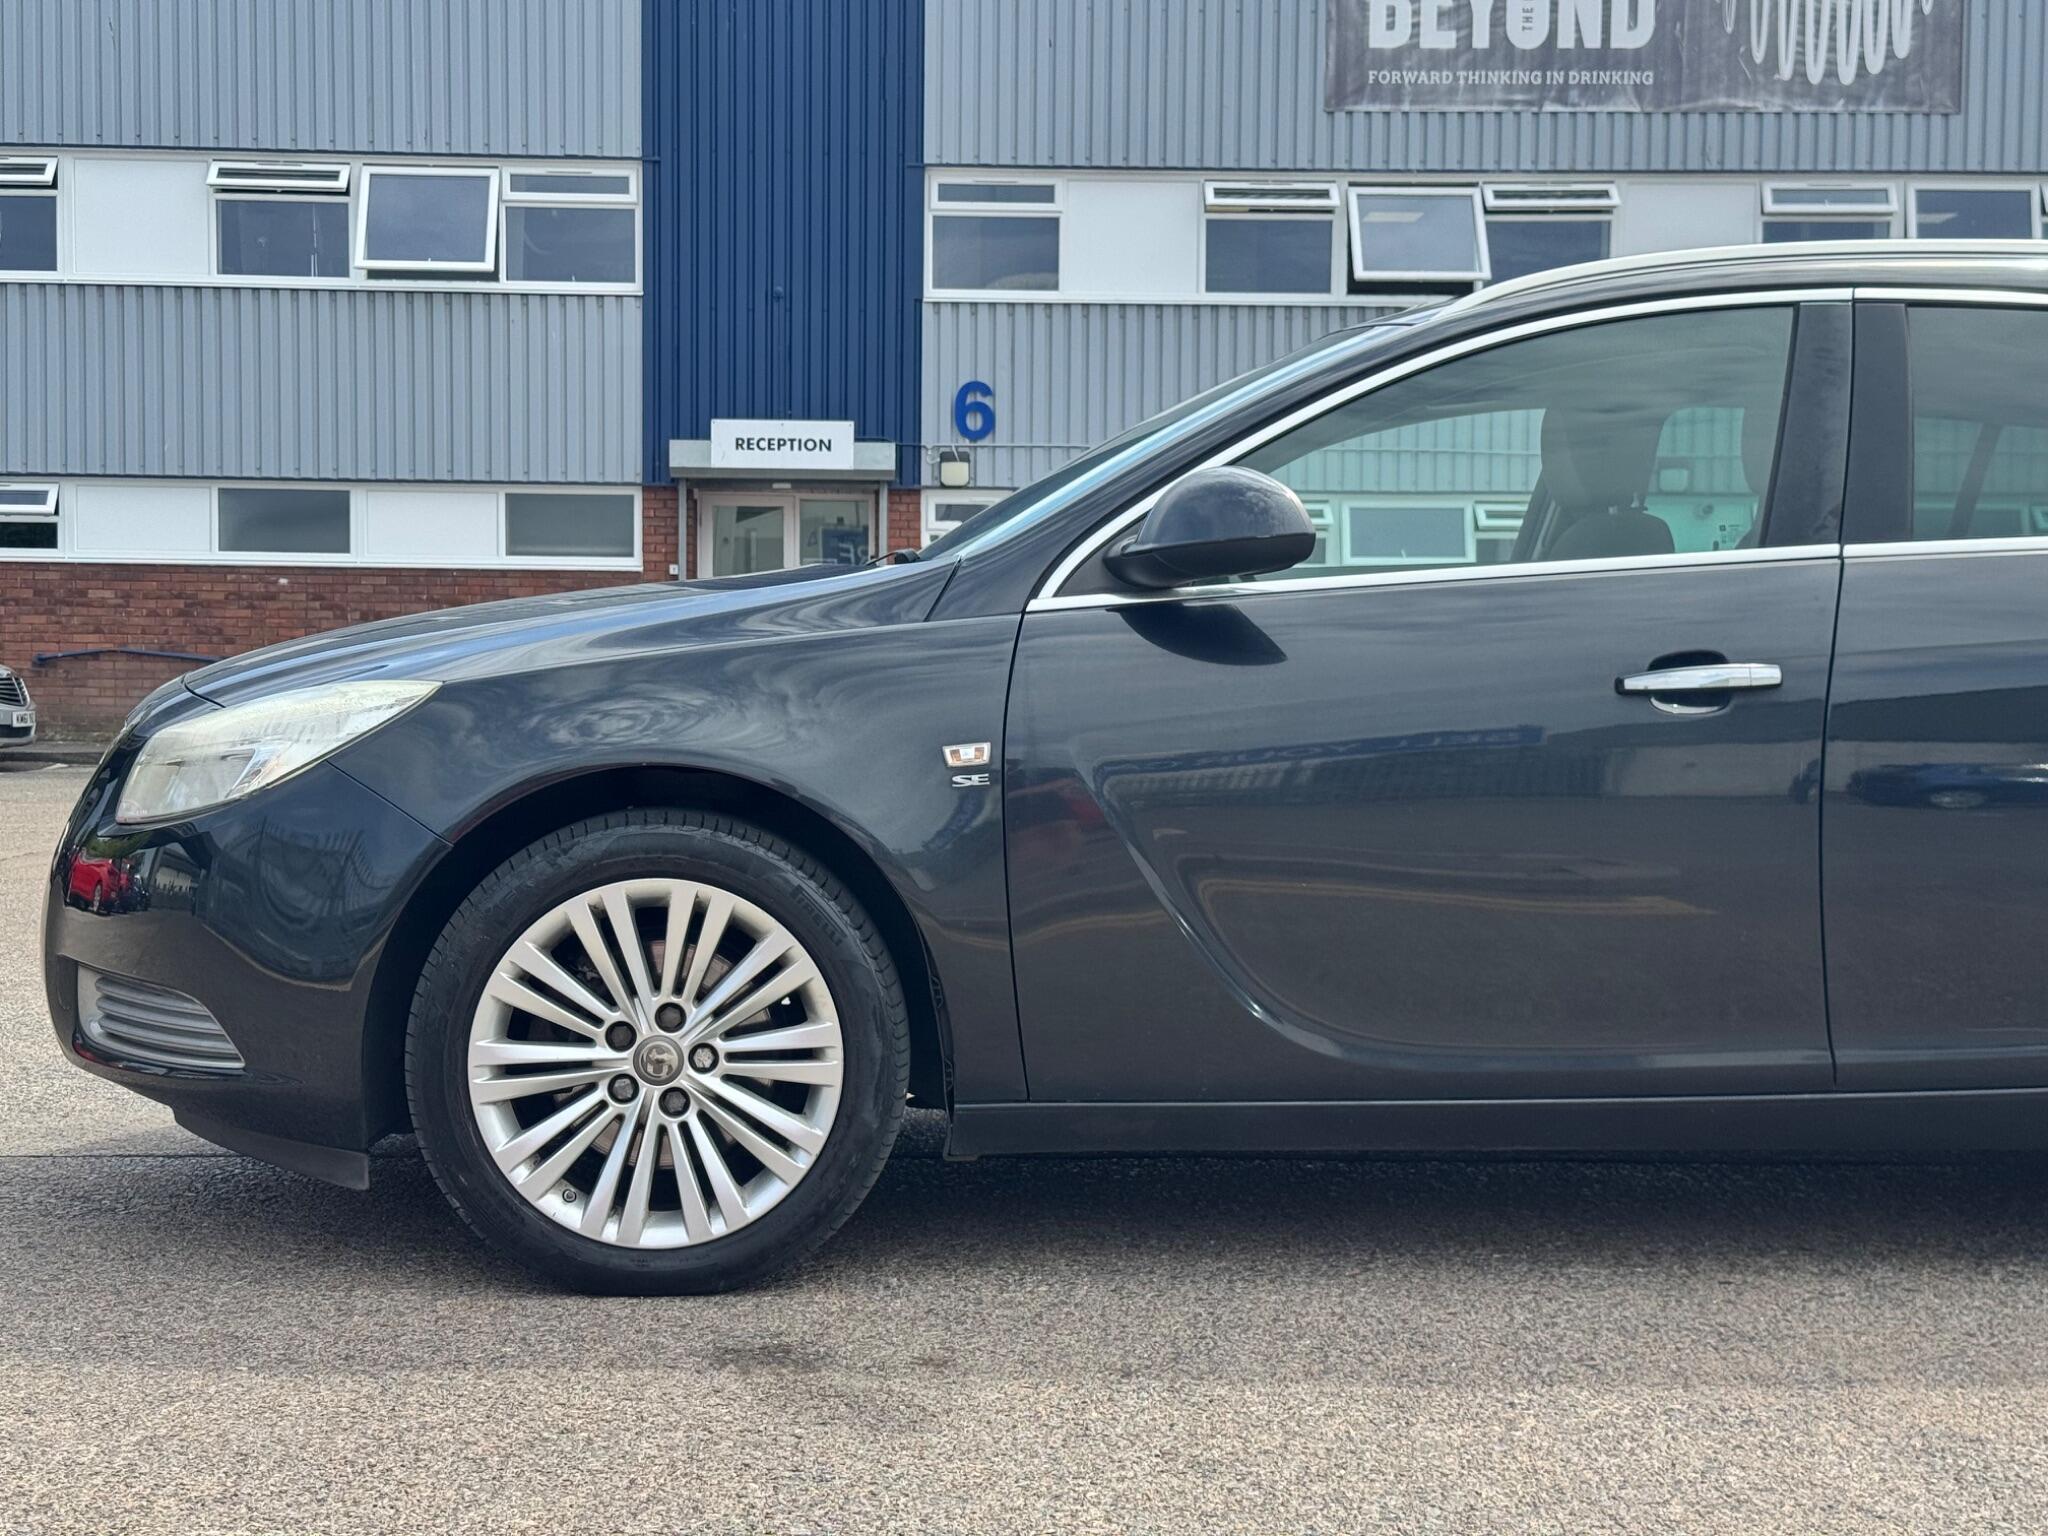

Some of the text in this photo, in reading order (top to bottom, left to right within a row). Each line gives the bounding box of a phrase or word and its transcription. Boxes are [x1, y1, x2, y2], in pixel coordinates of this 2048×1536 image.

[1522, 7, 1534, 31] THE
[1368, 70, 1654, 85] FORWARD THINKING IN DRINKING
[955, 380, 995, 442] 6
[735, 437, 832, 452] RECEPTION
[952, 773, 990, 788] SE
